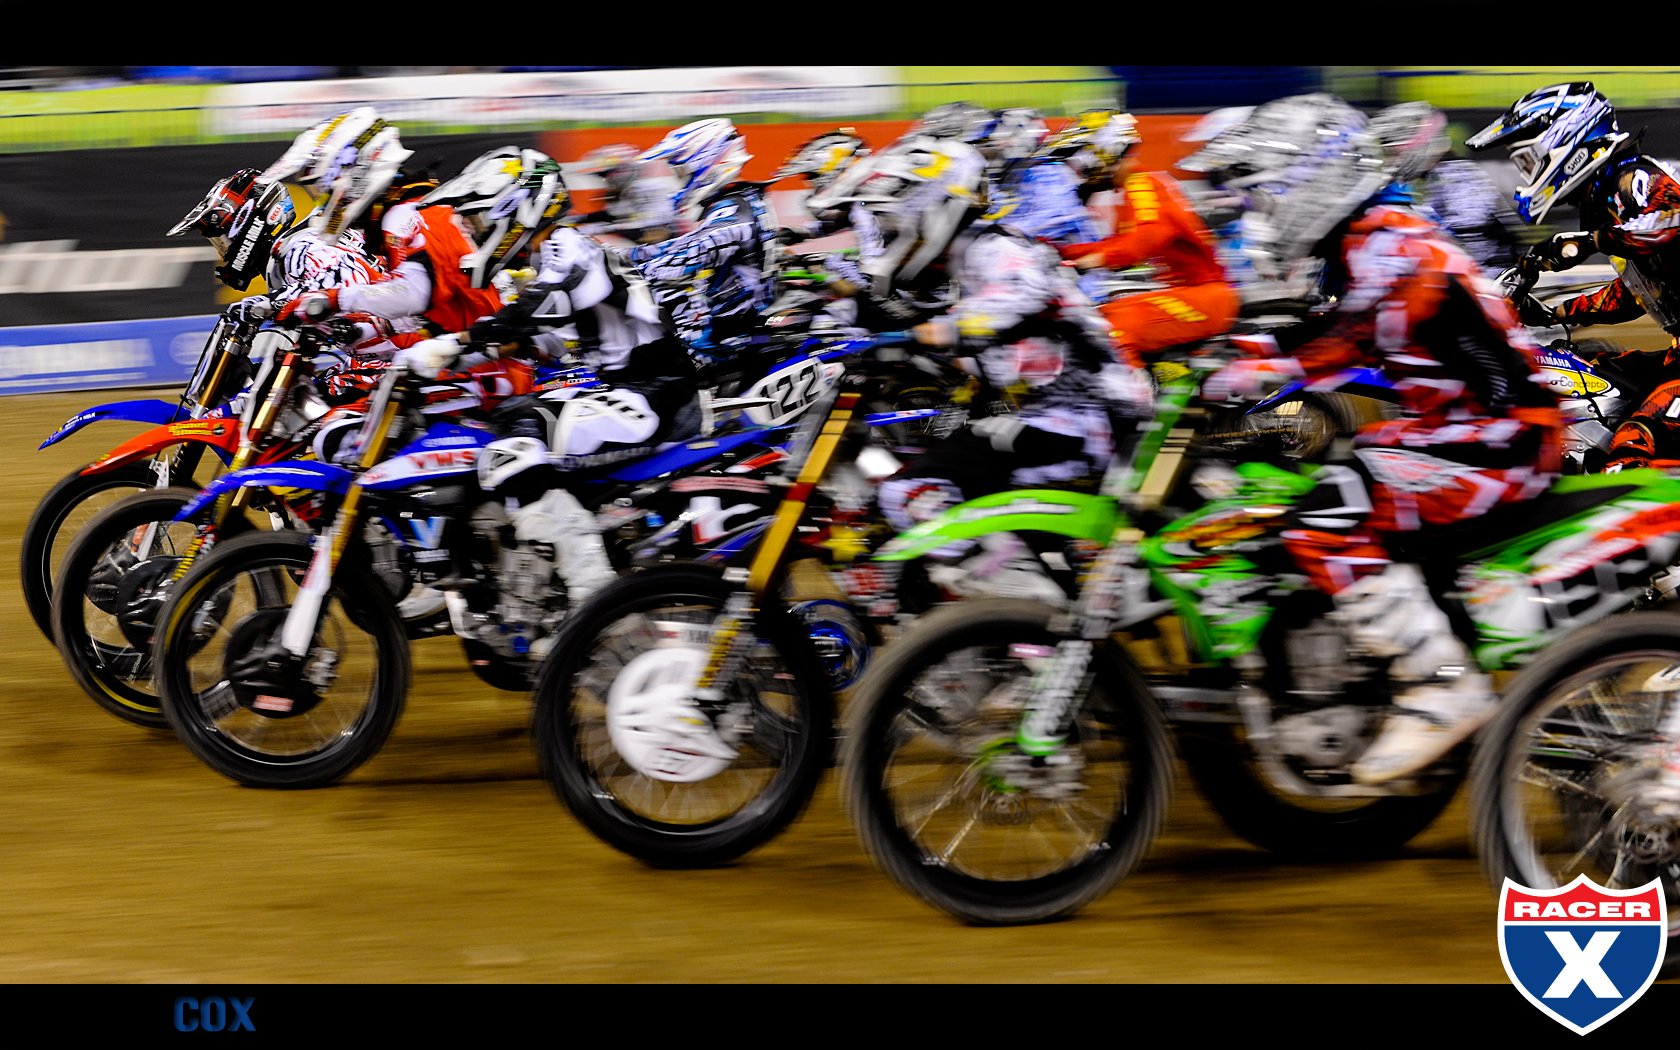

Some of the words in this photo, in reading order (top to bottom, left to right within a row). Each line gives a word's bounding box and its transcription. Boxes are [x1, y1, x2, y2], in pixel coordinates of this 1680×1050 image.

[1567, 151, 1586, 172] SHOEI
[231, 239, 255, 272] MUSCLE
[245, 216, 265, 242] MILK
[1533, 355, 1572, 368] YAMAHA
[760, 363, 821, 420] 122
